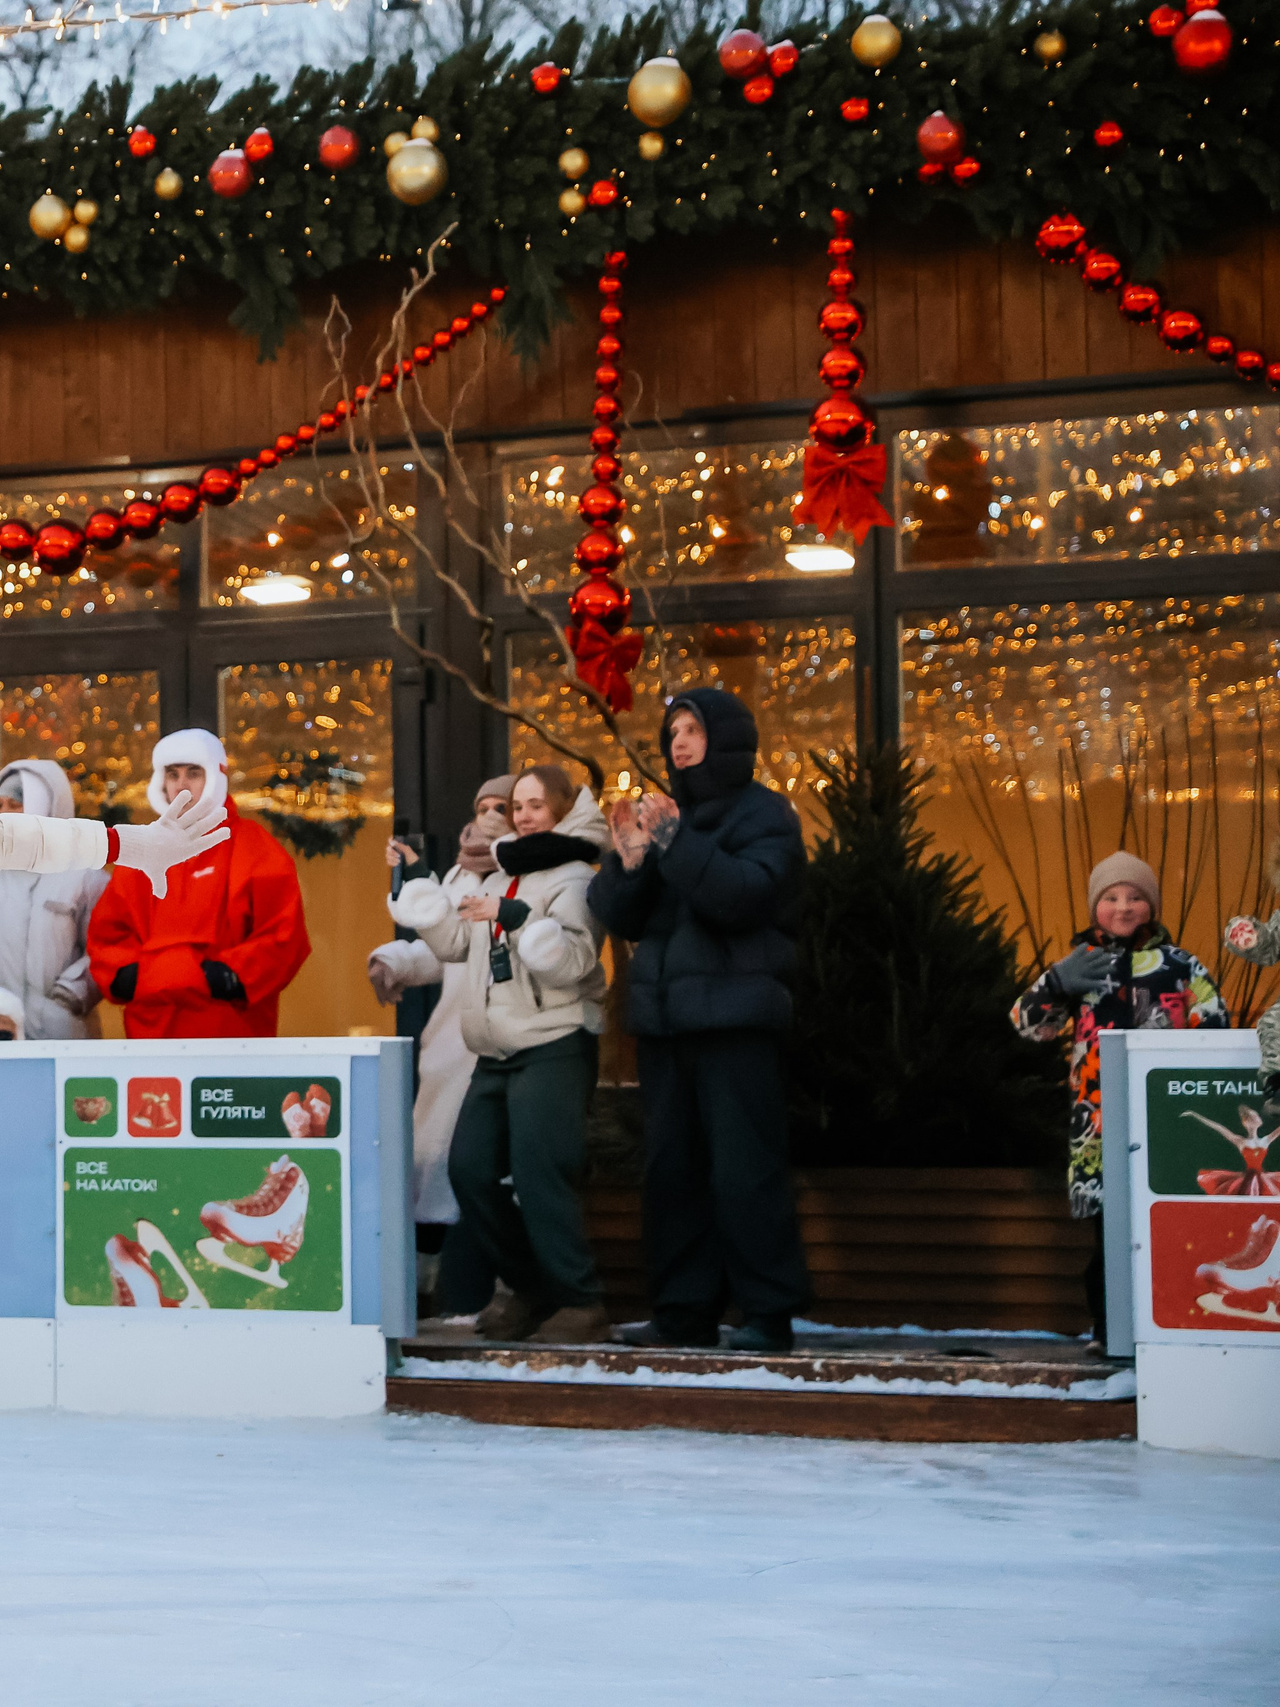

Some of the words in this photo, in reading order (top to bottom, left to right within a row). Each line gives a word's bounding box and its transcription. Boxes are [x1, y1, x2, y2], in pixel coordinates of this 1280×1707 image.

[1168, 1080, 1209, 1096] ВСЕ
[200, 1089, 233, 1103] ВСЕ
[200, 1106, 266, 1119] ГУЛЯТЬ!
[75, 1161, 108, 1175] ВСЕ
[75, 1179, 100, 1192] НА
[101, 1179, 158, 1192] КАТОК!
